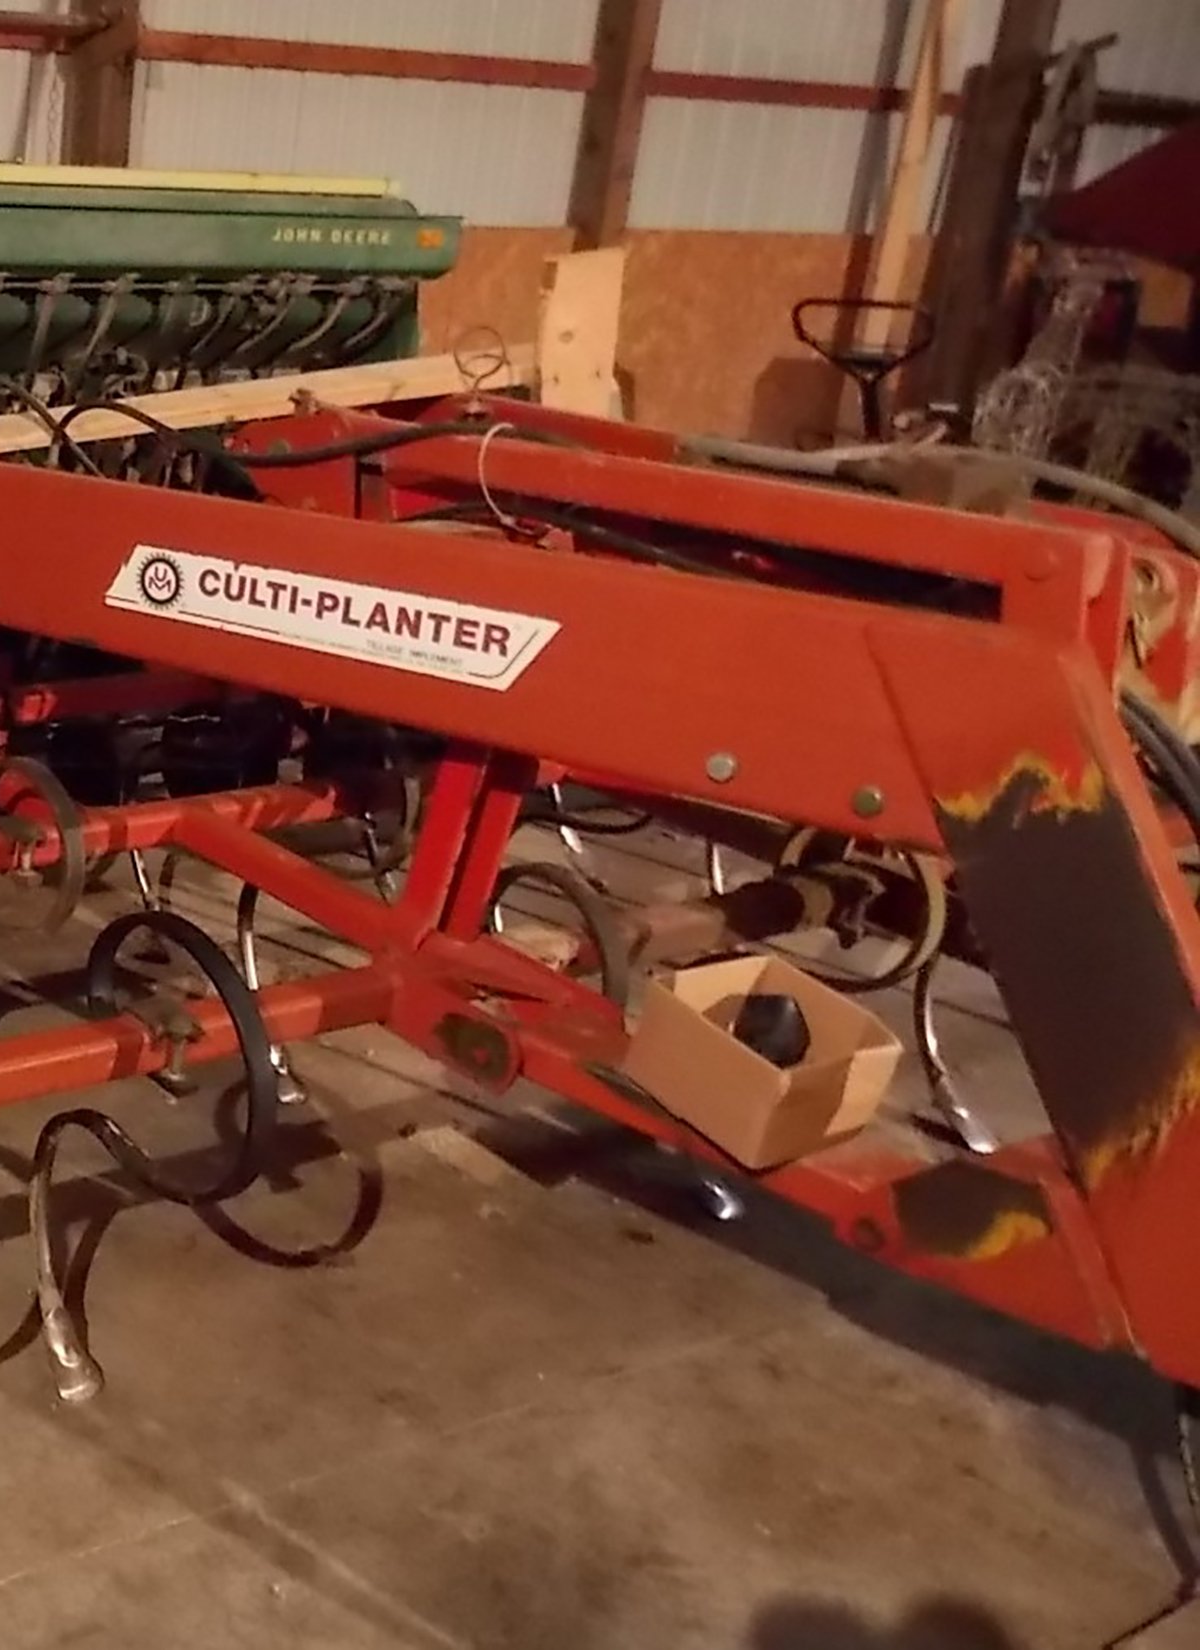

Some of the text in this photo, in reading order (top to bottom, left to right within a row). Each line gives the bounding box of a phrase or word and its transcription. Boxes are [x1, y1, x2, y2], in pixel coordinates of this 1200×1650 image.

[273, 227, 390, 245] JOHN DEERE
[198, 569, 510, 657] CULTI-PLANTER
